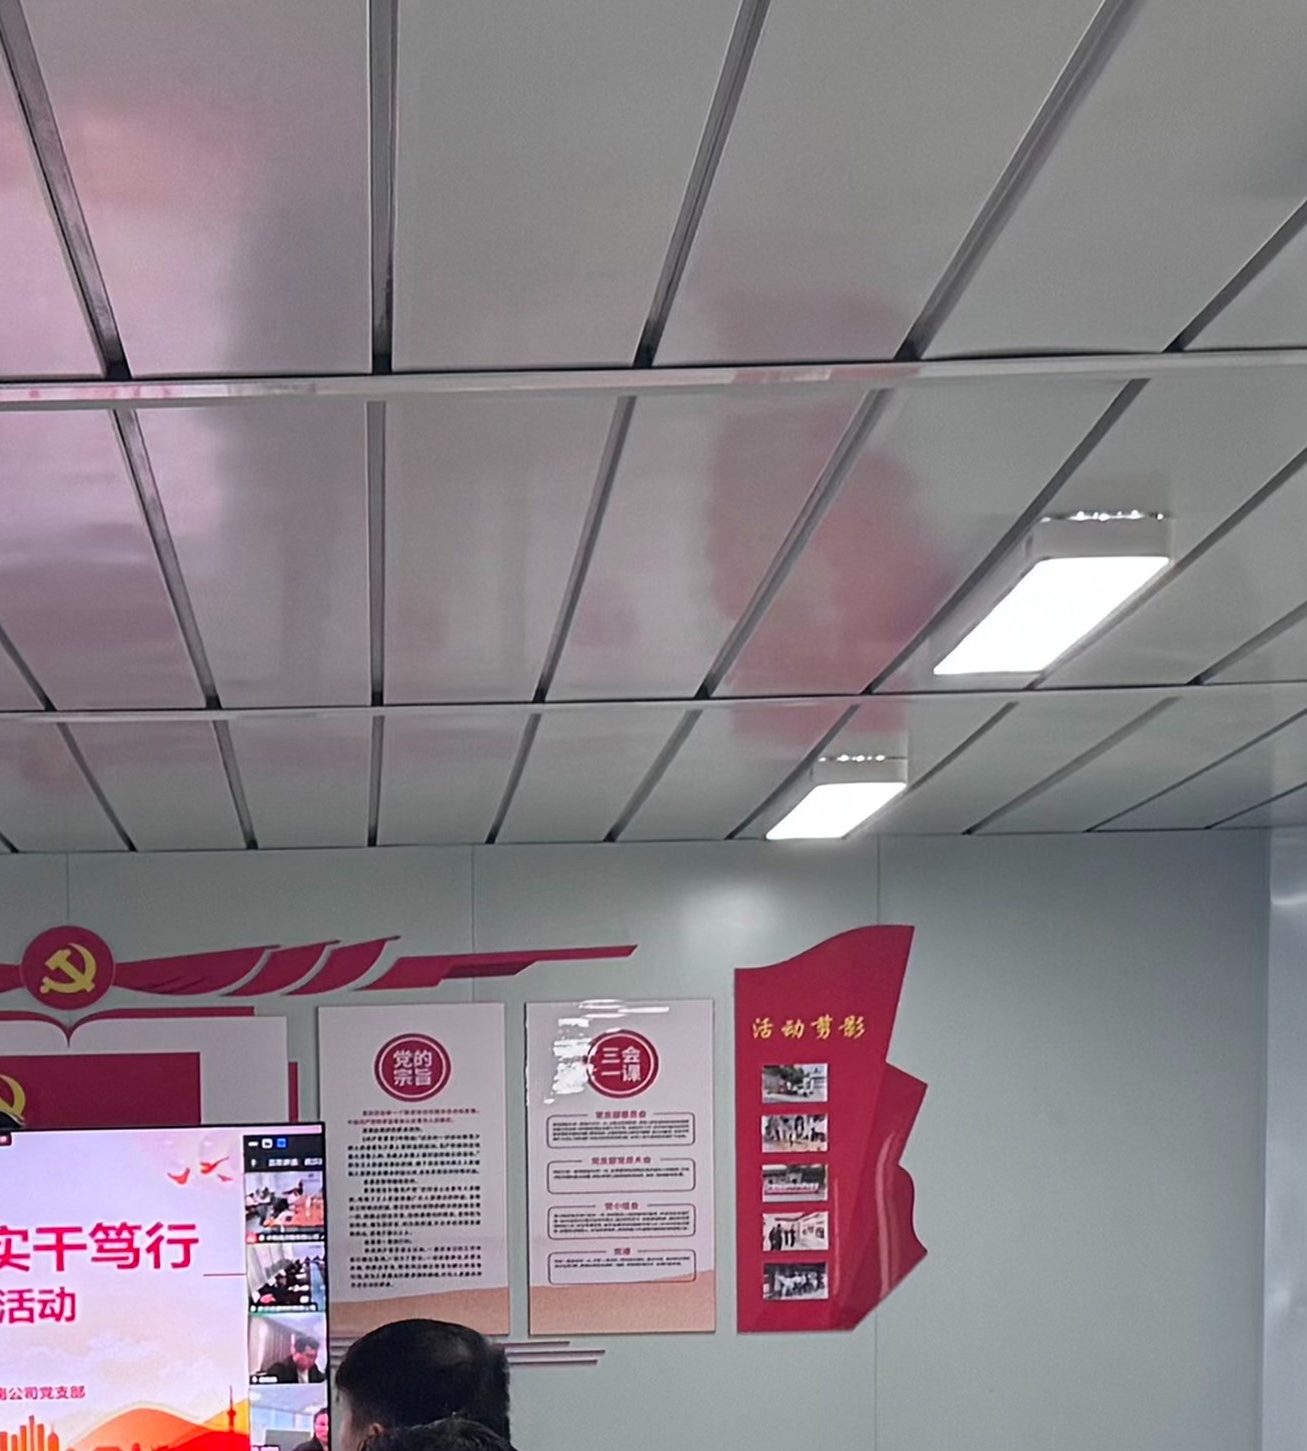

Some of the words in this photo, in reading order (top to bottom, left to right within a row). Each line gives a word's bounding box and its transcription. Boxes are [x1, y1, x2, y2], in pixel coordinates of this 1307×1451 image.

[752, 1014, 866, 1039] 活动剪影
[393, 1049, 433, 1068] 党的
[601, 1046, 641, 1064] 三会
[393, 1068, 432, 1086] 宗旨
[601, 1064, 642, 1082] 一课
